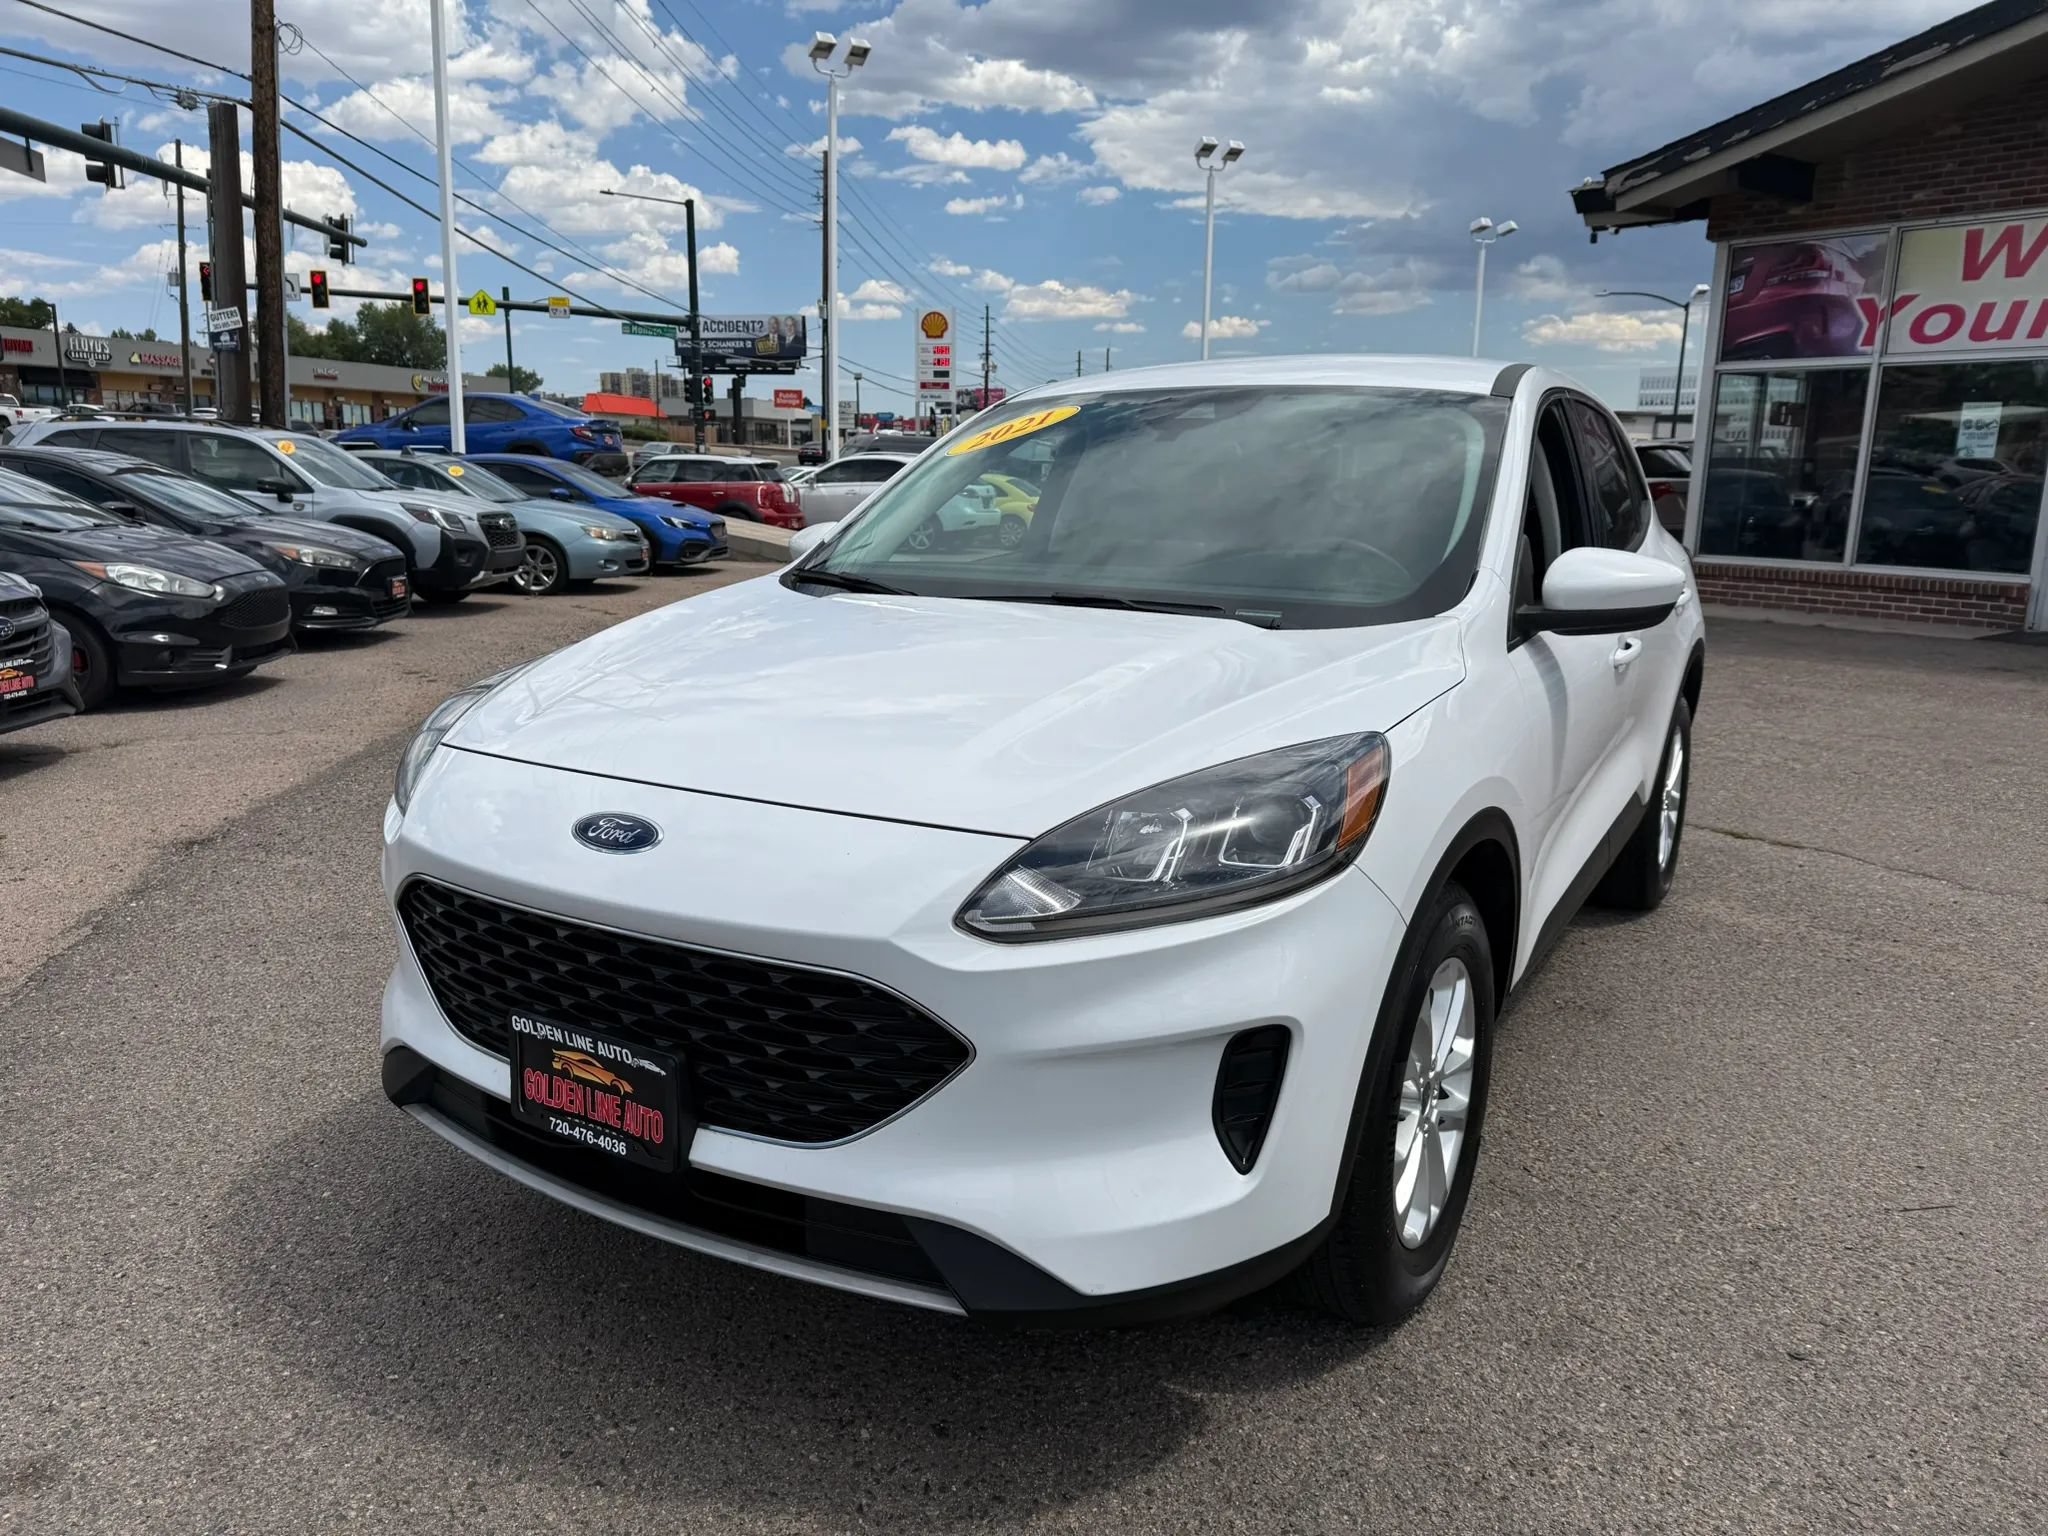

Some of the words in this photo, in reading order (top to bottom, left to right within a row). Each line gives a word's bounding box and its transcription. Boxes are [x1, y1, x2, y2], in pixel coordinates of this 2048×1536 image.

[210, 310, 239, 322] GUTTERS
[703, 320, 763, 333] ACCIDENT?
[70, 337, 110, 353] FLOYD'S
[776, 398, 800, 406] Storage
[968, 411, 1056, 450] 2021
[588, 817, 642, 844] Ford
[512, 1015, 564, 1043] GOLDEN
[565, 1030, 595, 1053] LINE
[597, 1040, 632, 1064] AUTO
[524, 1067, 584, 1115] GOLDEN
[585, 1085, 622, 1128] LINE
[624, 1100, 664, 1144] AUTO
[549, 1116, 627, 1155] 720-476-4036
